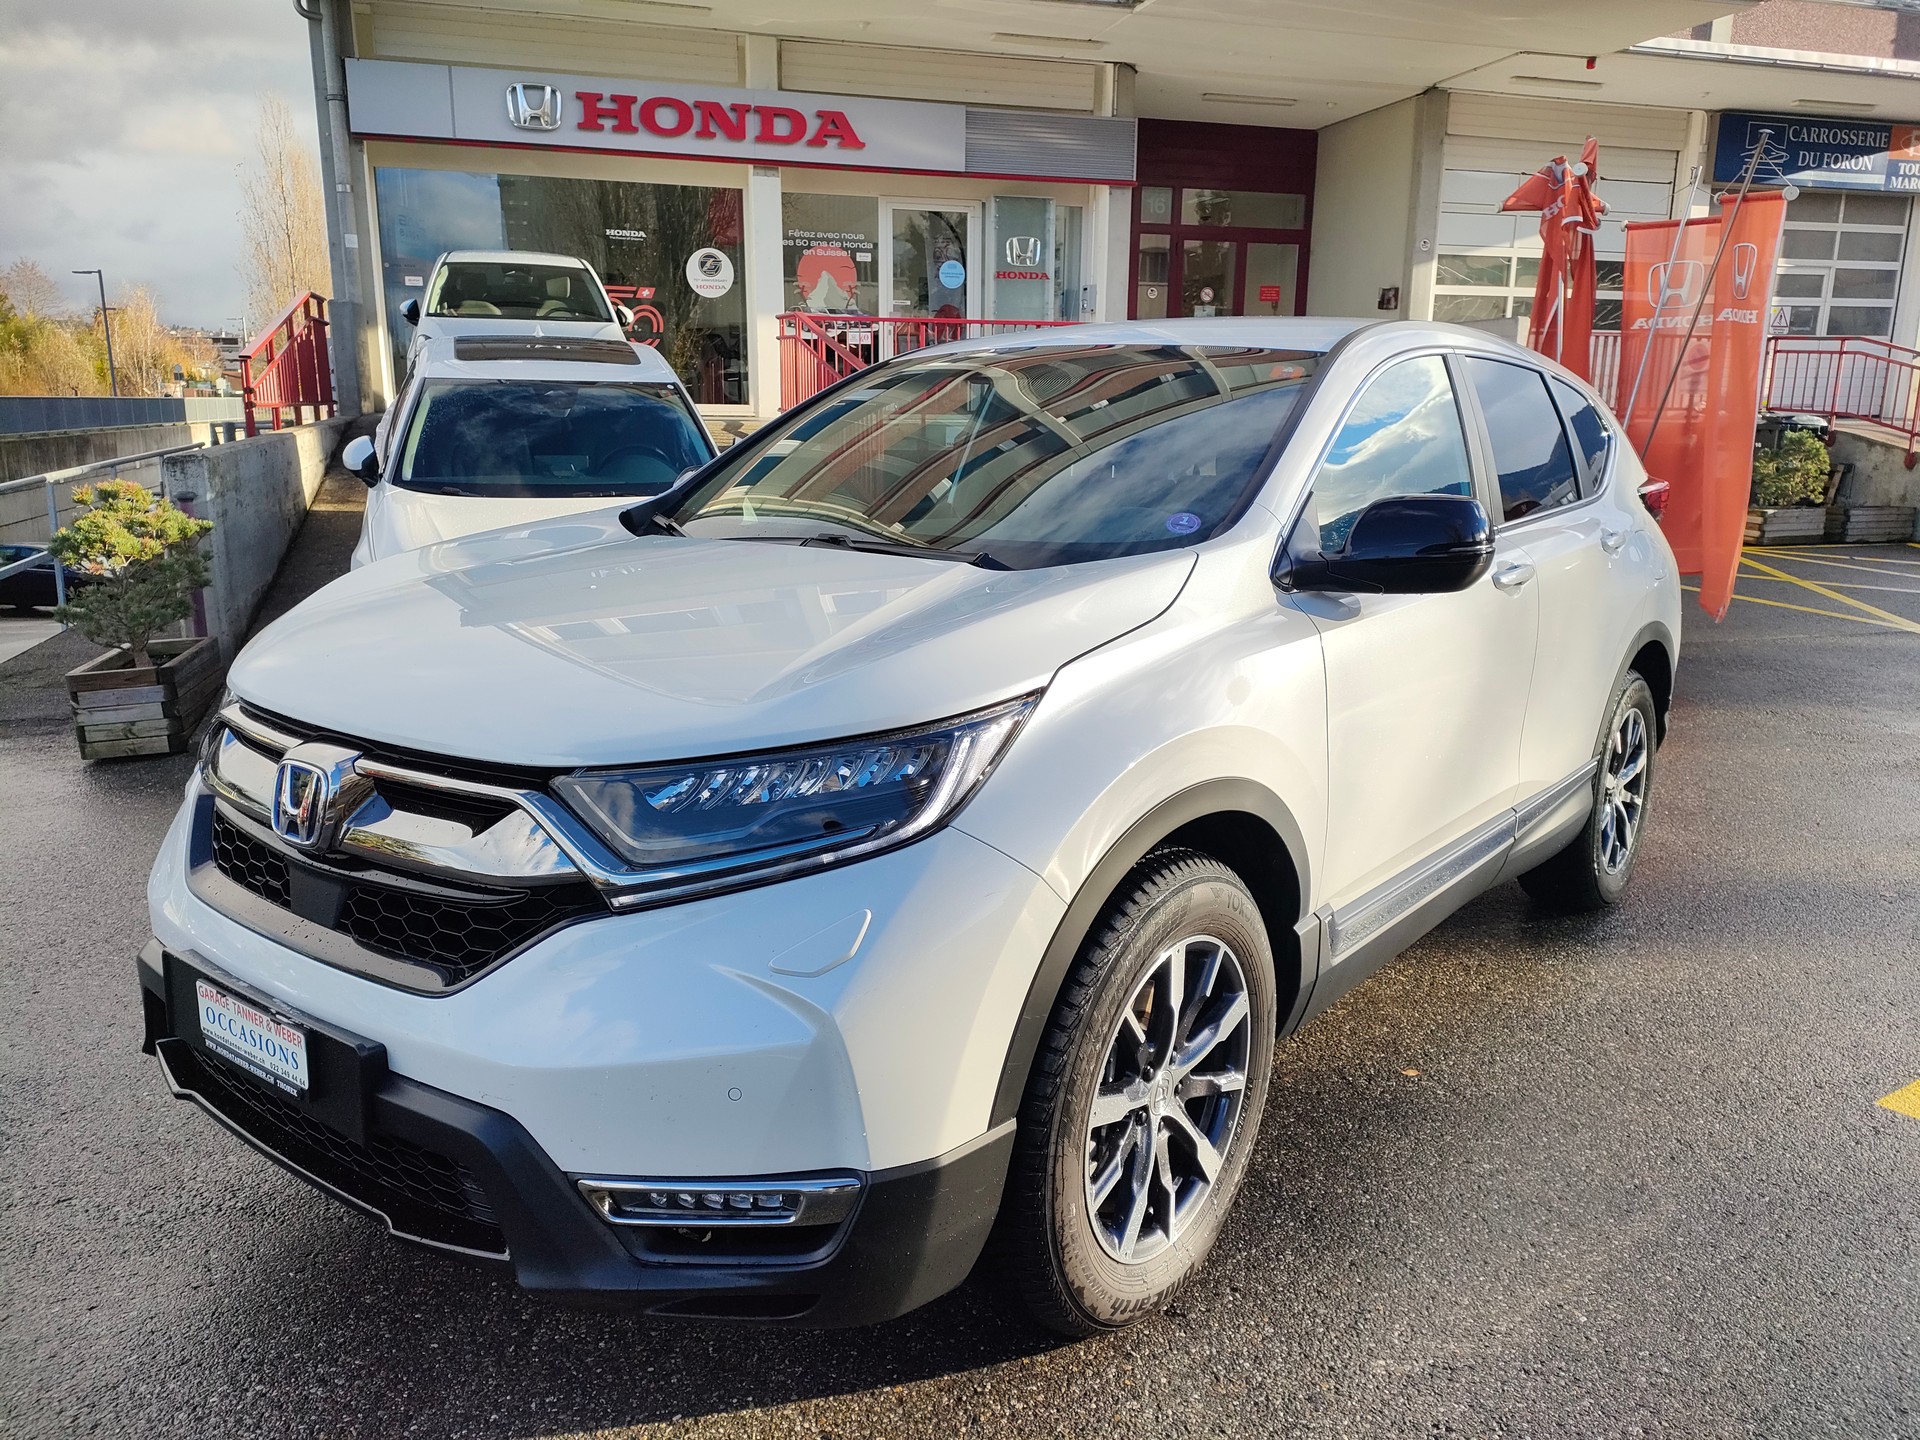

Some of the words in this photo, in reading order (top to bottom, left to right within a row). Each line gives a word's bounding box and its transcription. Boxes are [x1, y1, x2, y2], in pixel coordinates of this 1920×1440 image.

[576, 91, 865, 149] HONDA
[1789, 125, 1889, 148] CARROSSERIE
[1798, 150, 1820, 168] DU
[1823, 152, 1873, 171] FORON
[1147, 195, 1166, 214] 16
[605, 229, 647, 238] HONDA
[788, 229, 815, 238] Fêtez
[816, 231, 839, 239] avec
[841, 232, 864, 240] nous
[828, 240, 841, 248] de
[843, 241, 873, 249] Honda
[996, 271, 1050, 280] HONDA
[199, 985, 230, 1010] GARAGE
[232, 1001, 264, 1030] TANNER
[266, 1020, 272, 1033] &
[273, 1022, 302, 1050] WEBER
[206, 1006, 299, 1070] OCCASIONS
[270, 1062, 280, 1072] 022
[280, 1067, 290, 1078] 349
